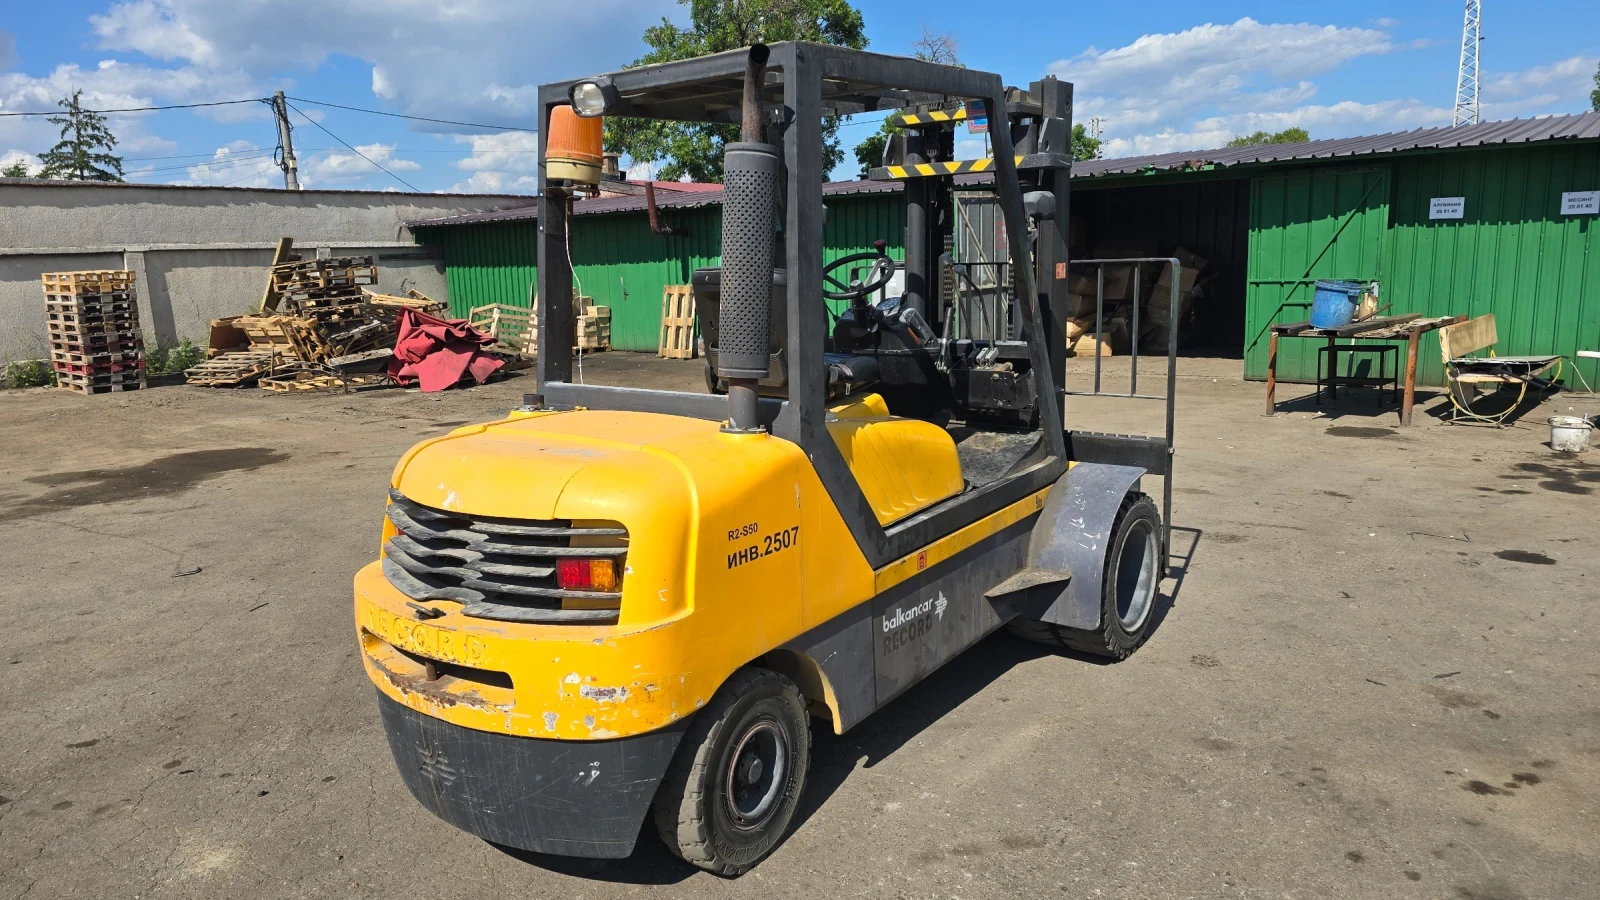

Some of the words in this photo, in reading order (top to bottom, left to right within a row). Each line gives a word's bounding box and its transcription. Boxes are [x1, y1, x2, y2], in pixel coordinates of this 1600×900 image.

[727, 525, 799, 570] ИНВ.2507
[728, 522, 758, 541] R2-S50
[882, 598, 933, 632] balkancar
[883, 613, 933, 656] RECORD
